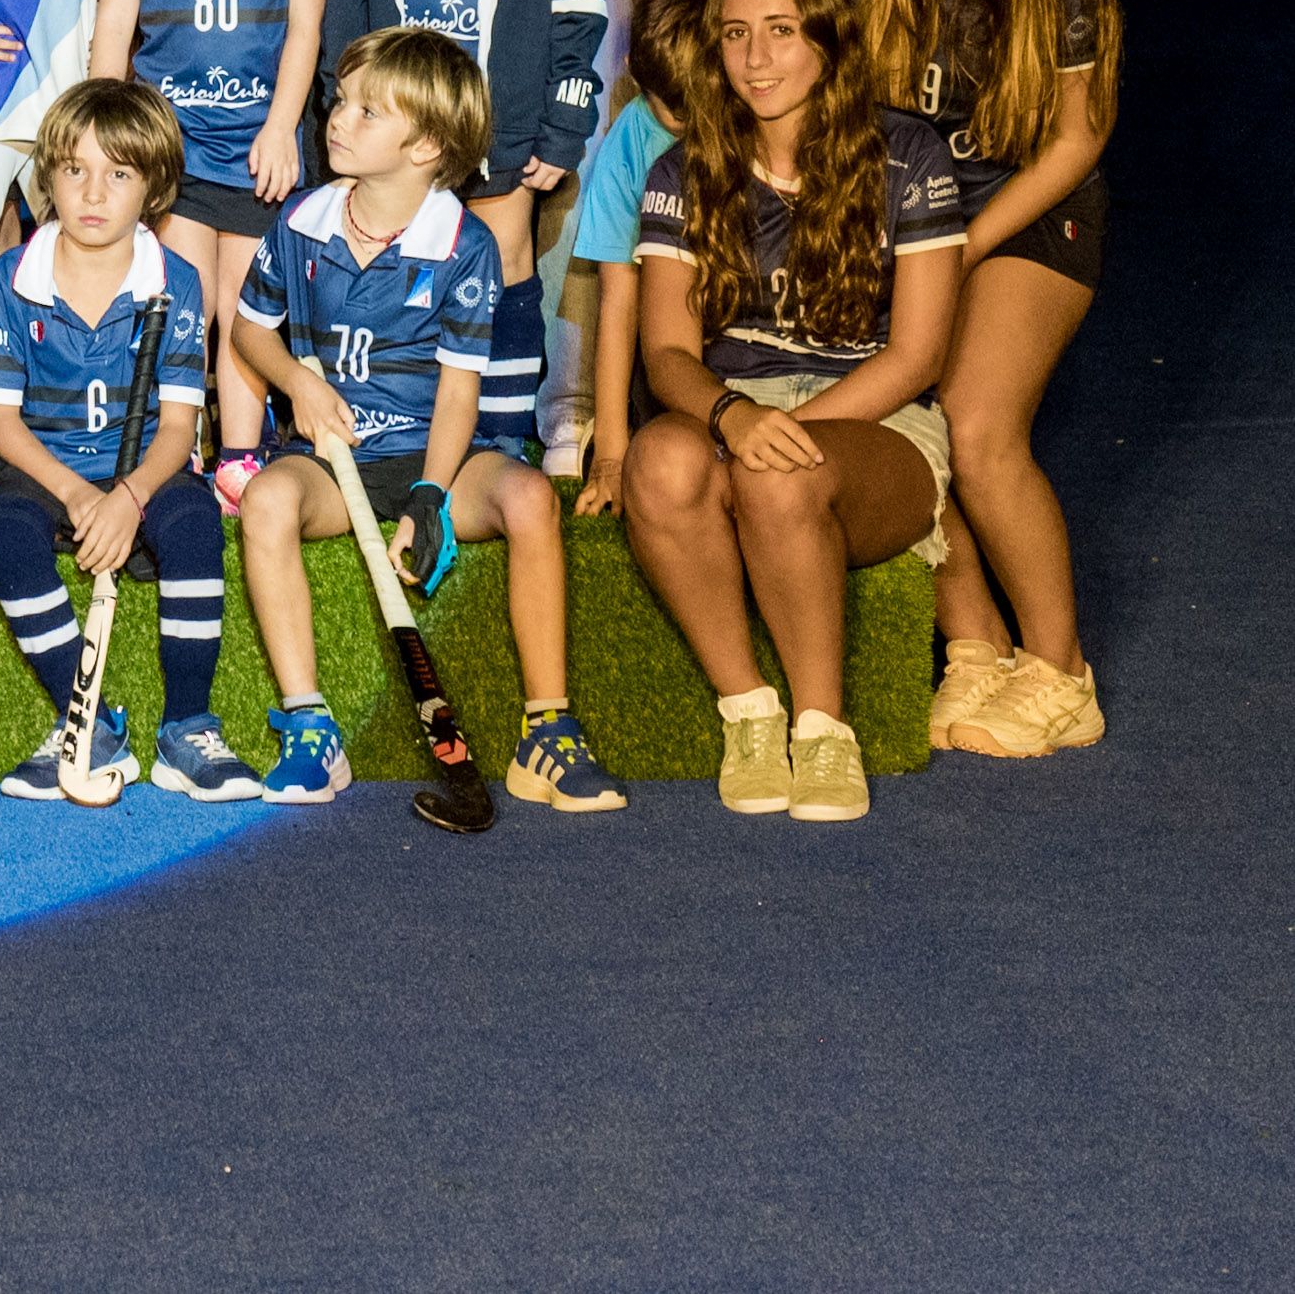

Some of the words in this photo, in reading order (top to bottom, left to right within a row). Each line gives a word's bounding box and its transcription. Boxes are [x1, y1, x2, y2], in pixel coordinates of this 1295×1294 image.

[160, 77, 219, 103] Enjoy
[555, 77, 594, 109] AMC
[921, 63, 940, 117] 9
[330, 323, 374, 384] 70
[86, 378, 109, 434] 6
